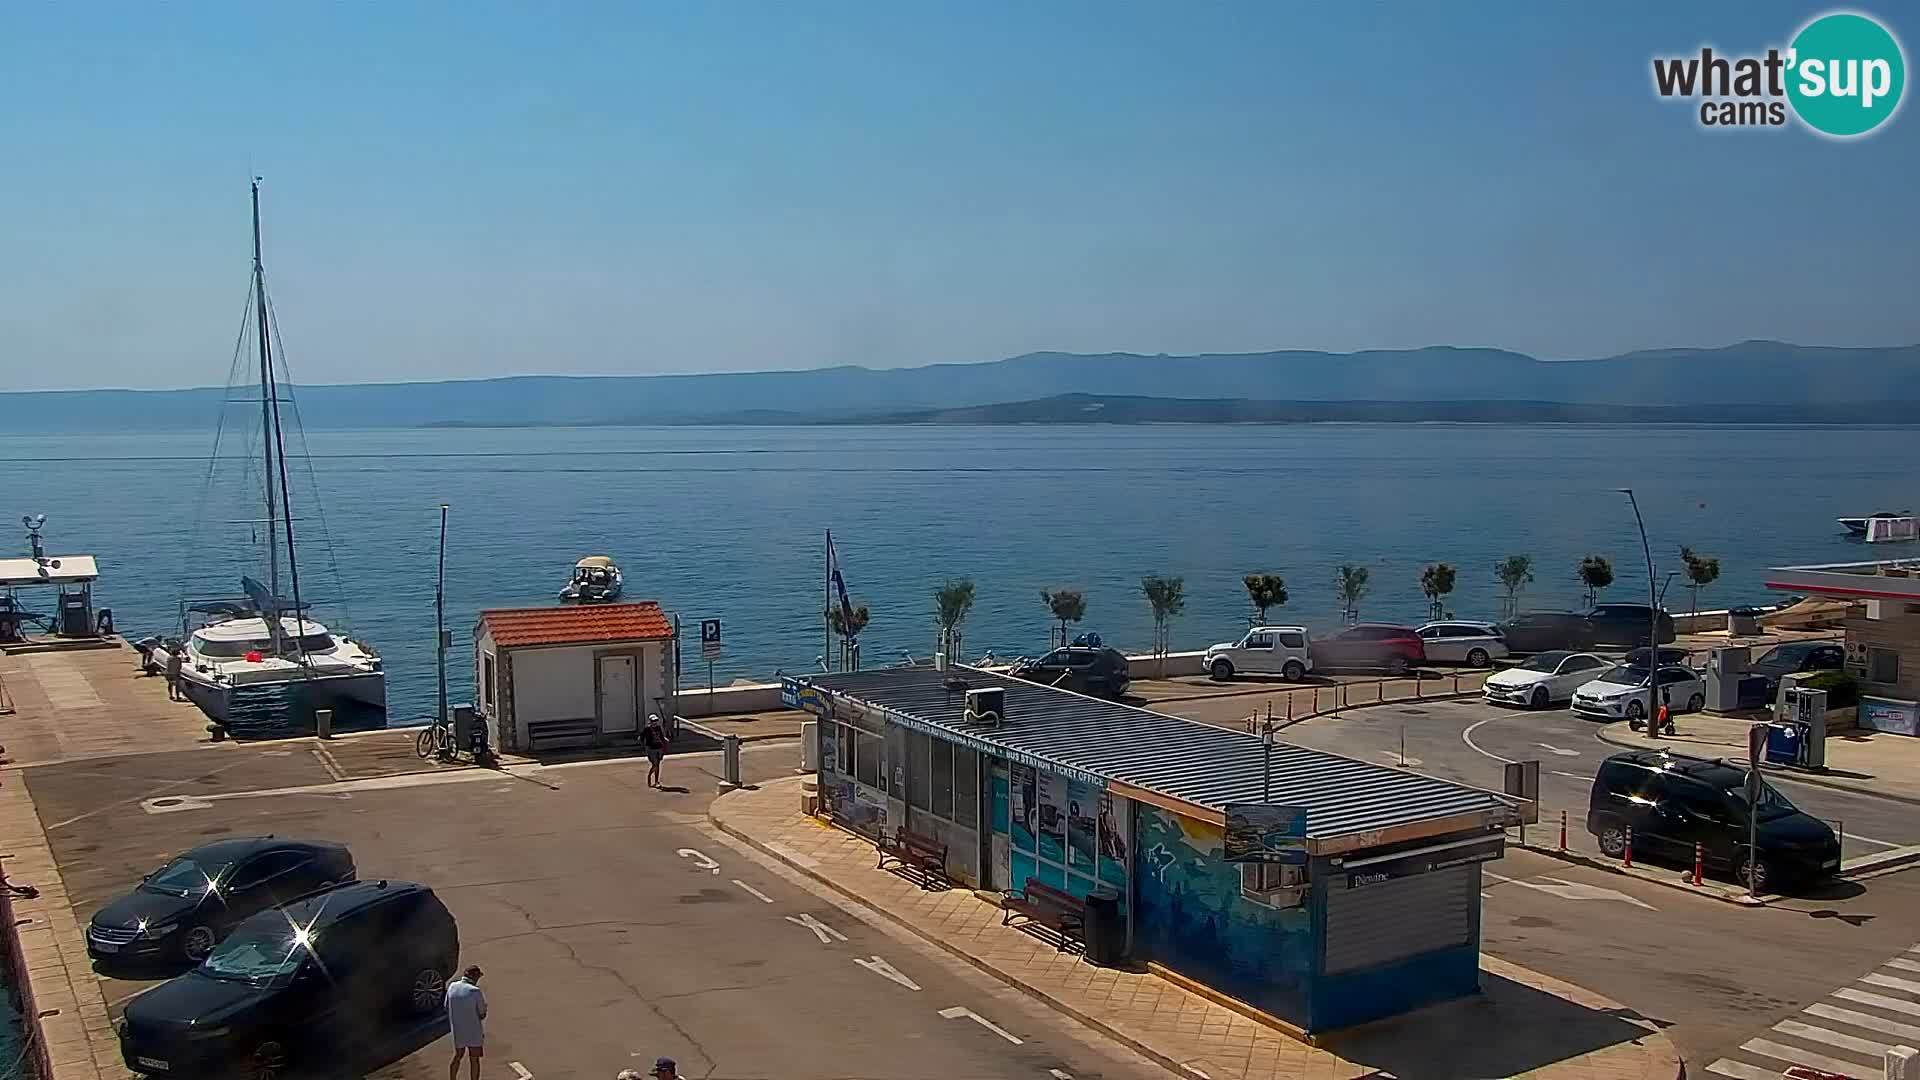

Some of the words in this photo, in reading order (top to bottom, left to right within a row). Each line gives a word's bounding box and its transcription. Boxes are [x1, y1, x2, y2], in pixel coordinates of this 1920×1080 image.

[706, 623, 716, 639] P
[1006, 750, 1019, 761] BUS
[1021, 754, 1051, 770] STATION
[1053, 763, 1077, 780] TICKET
[1078, 771, 1104, 787] OFFICE
